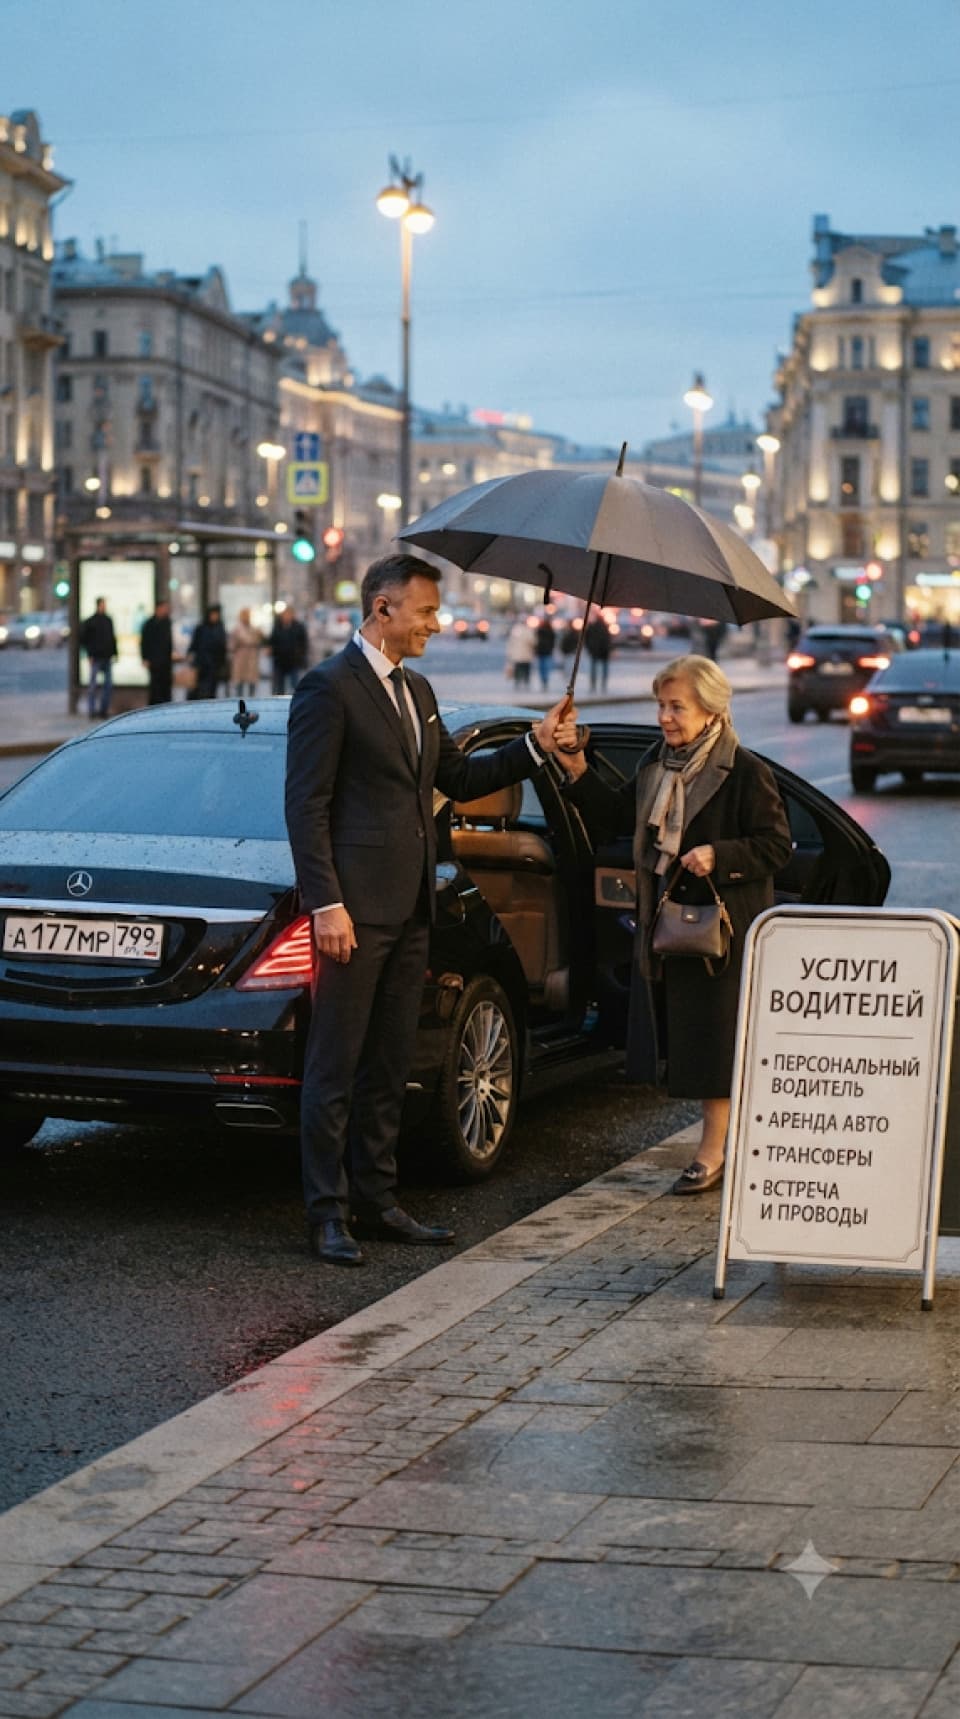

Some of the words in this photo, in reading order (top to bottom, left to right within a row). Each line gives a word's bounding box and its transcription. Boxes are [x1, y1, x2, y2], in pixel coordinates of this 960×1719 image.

[117, 925, 156, 947] 799
[800, 958, 898, 983] УСЛУГИ
[769, 989, 924, 1019] ВОДИТЕЛЕЙ
[773, 1053, 920, 1077] ПЕРСОНАЛЬНЫЙ
[771, 1078, 865, 1099] ВОДИТЕЛЬ
[768, 1111, 838, 1134] АРЕНДА
[842, 1113, 890, 1133] АВТО
[766, 1144, 873, 1167] ТРАНСФЕРЫ
[762, 1179, 840, 1200] ВСТРЕЧА
[760, 1203, 773, 1220] И
[777, 1204, 869, 1228] ПРОВОДЫ
